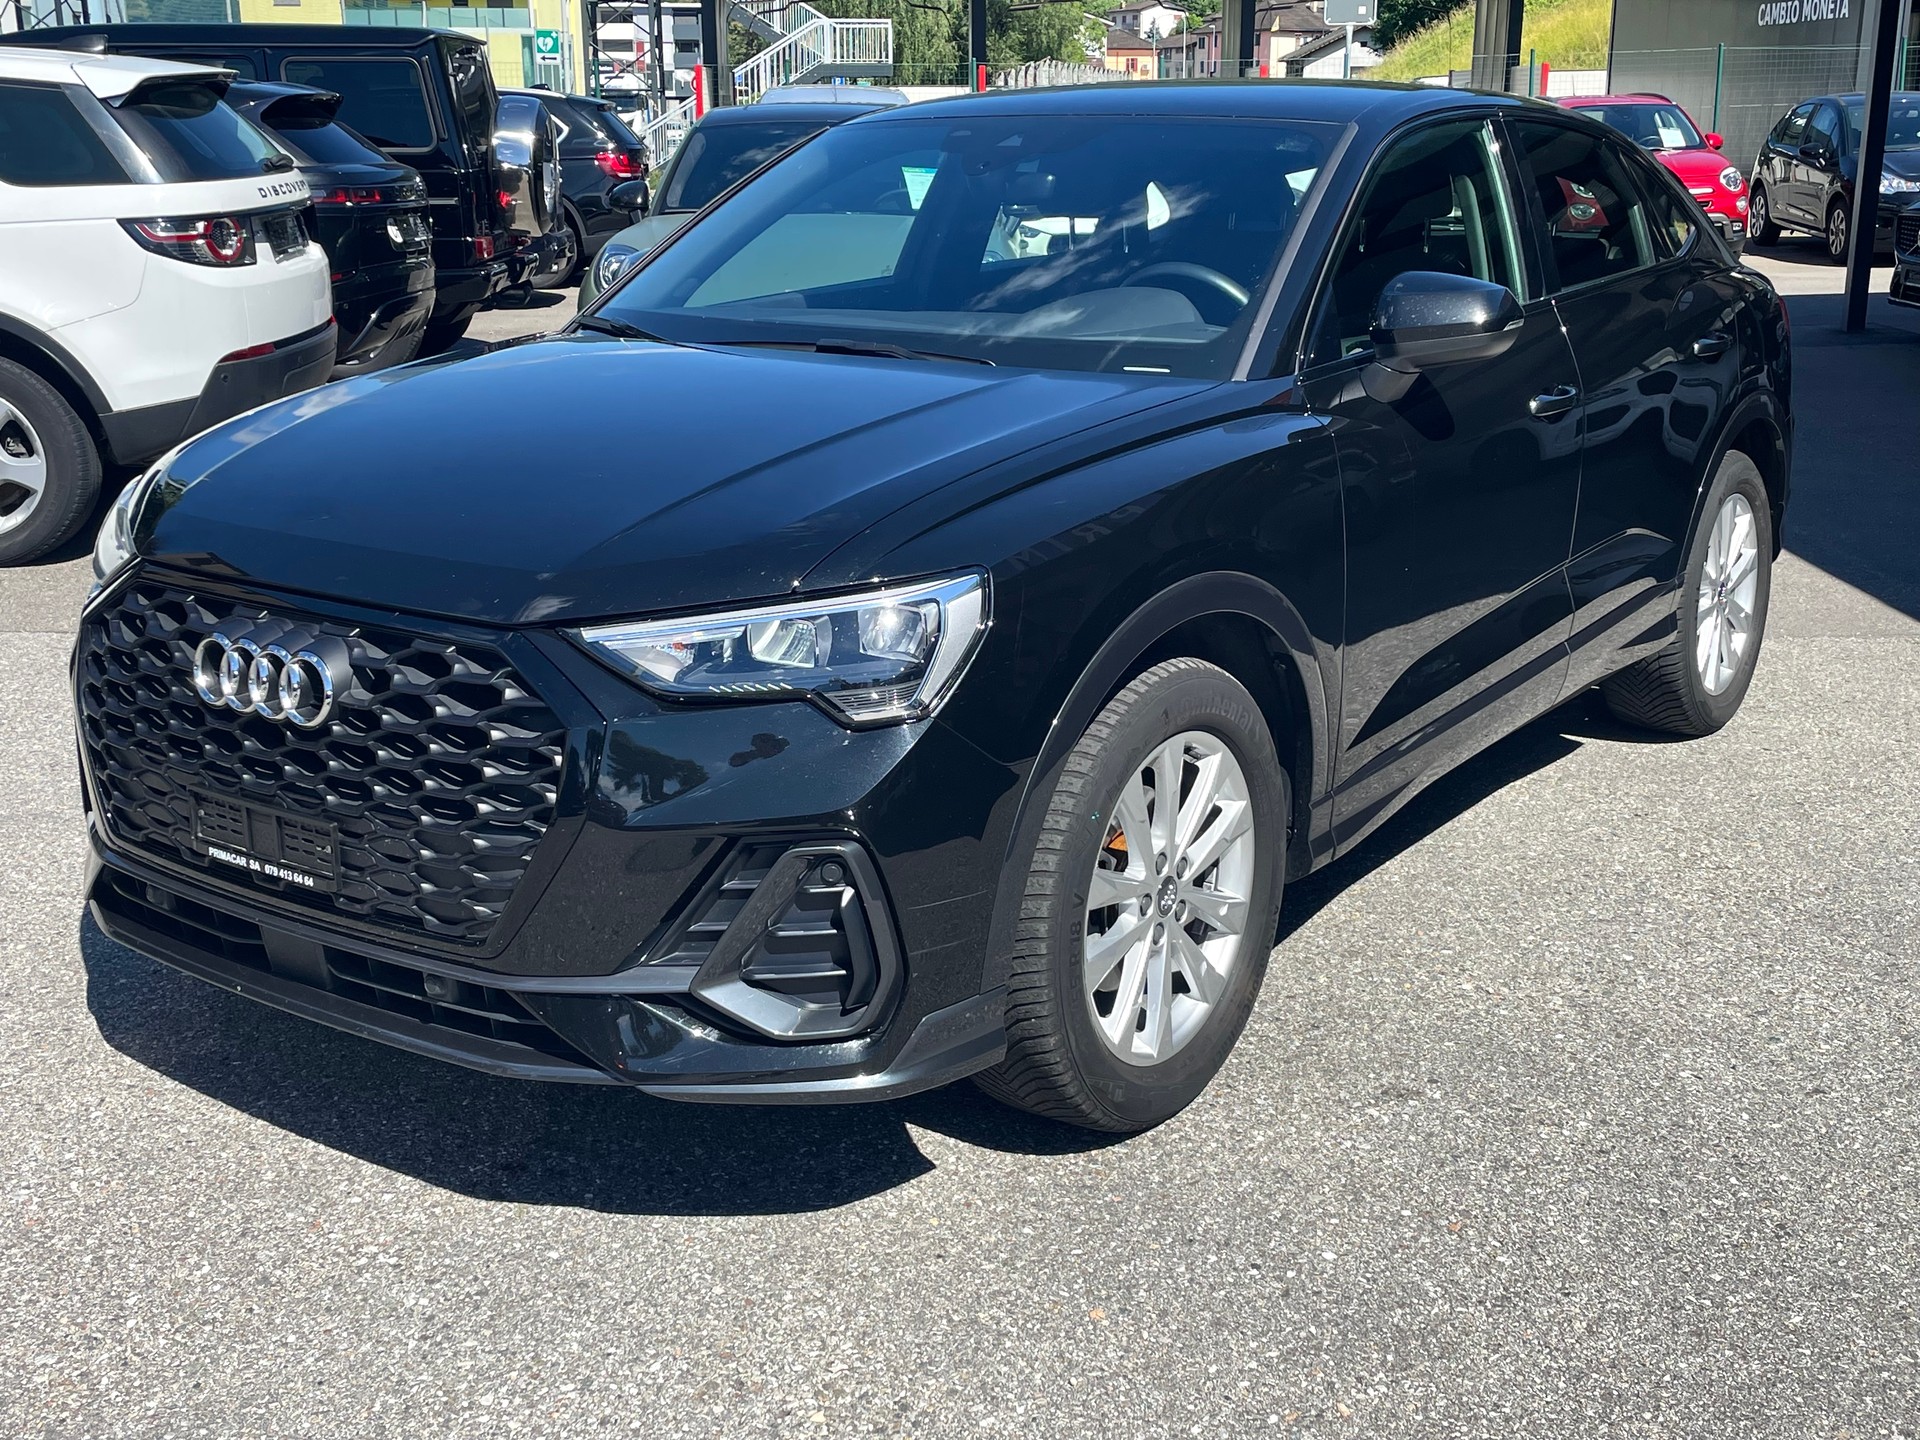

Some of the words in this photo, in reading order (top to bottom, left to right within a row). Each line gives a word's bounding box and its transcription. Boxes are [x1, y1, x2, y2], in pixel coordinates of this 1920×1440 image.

[1758, 0, 1800, 26] CAMBIO
[1801, 0, 1849, 22] MONETA
[208, 847, 247, 867] PRIMACAR
[249, 860, 261, 871] SA
[264, 864, 278, 877] 079
[279, 868, 293, 881] 413
[293, 873, 303, 884] 64
[304, 877, 314, 887] 64
